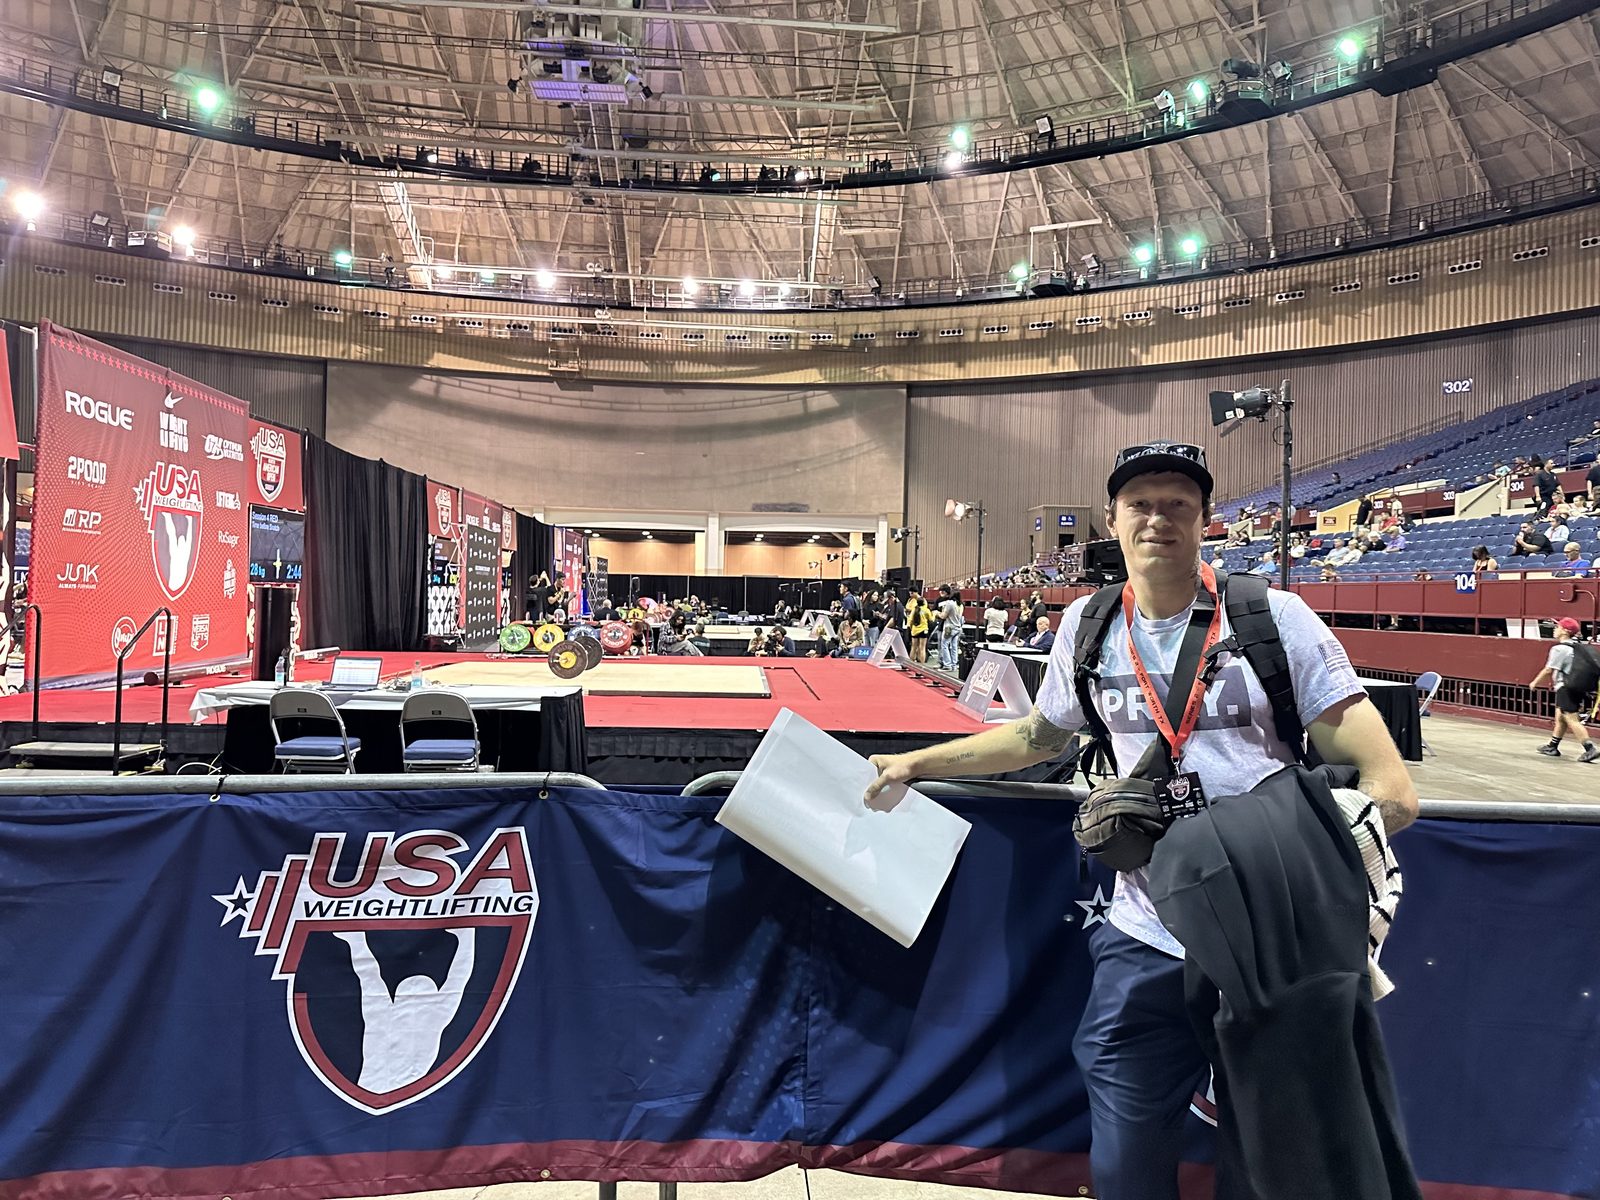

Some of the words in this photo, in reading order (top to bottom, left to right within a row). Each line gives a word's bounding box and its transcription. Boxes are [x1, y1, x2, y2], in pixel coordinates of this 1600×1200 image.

[1444, 380, 1471, 393] 302
[65, 390, 132, 431] ROGUE
[261, 428, 285, 452] USA
[155, 463, 202, 501] USA
[1510, 482, 1524, 492] 304
[1443, 491, 1455, 501] 303
[78, 509, 102, 529] RP
[56, 563, 100, 583] JUNK
[286, 564, 302, 579] 2:44
[1455, 574, 1477, 590] 104
[206, 665, 227, 675] ROGUE
[1101, 678, 1240, 722] PRY.
[308, 829, 533, 899] USA
[303, 895, 535, 918] WEIGHTLIFTING
